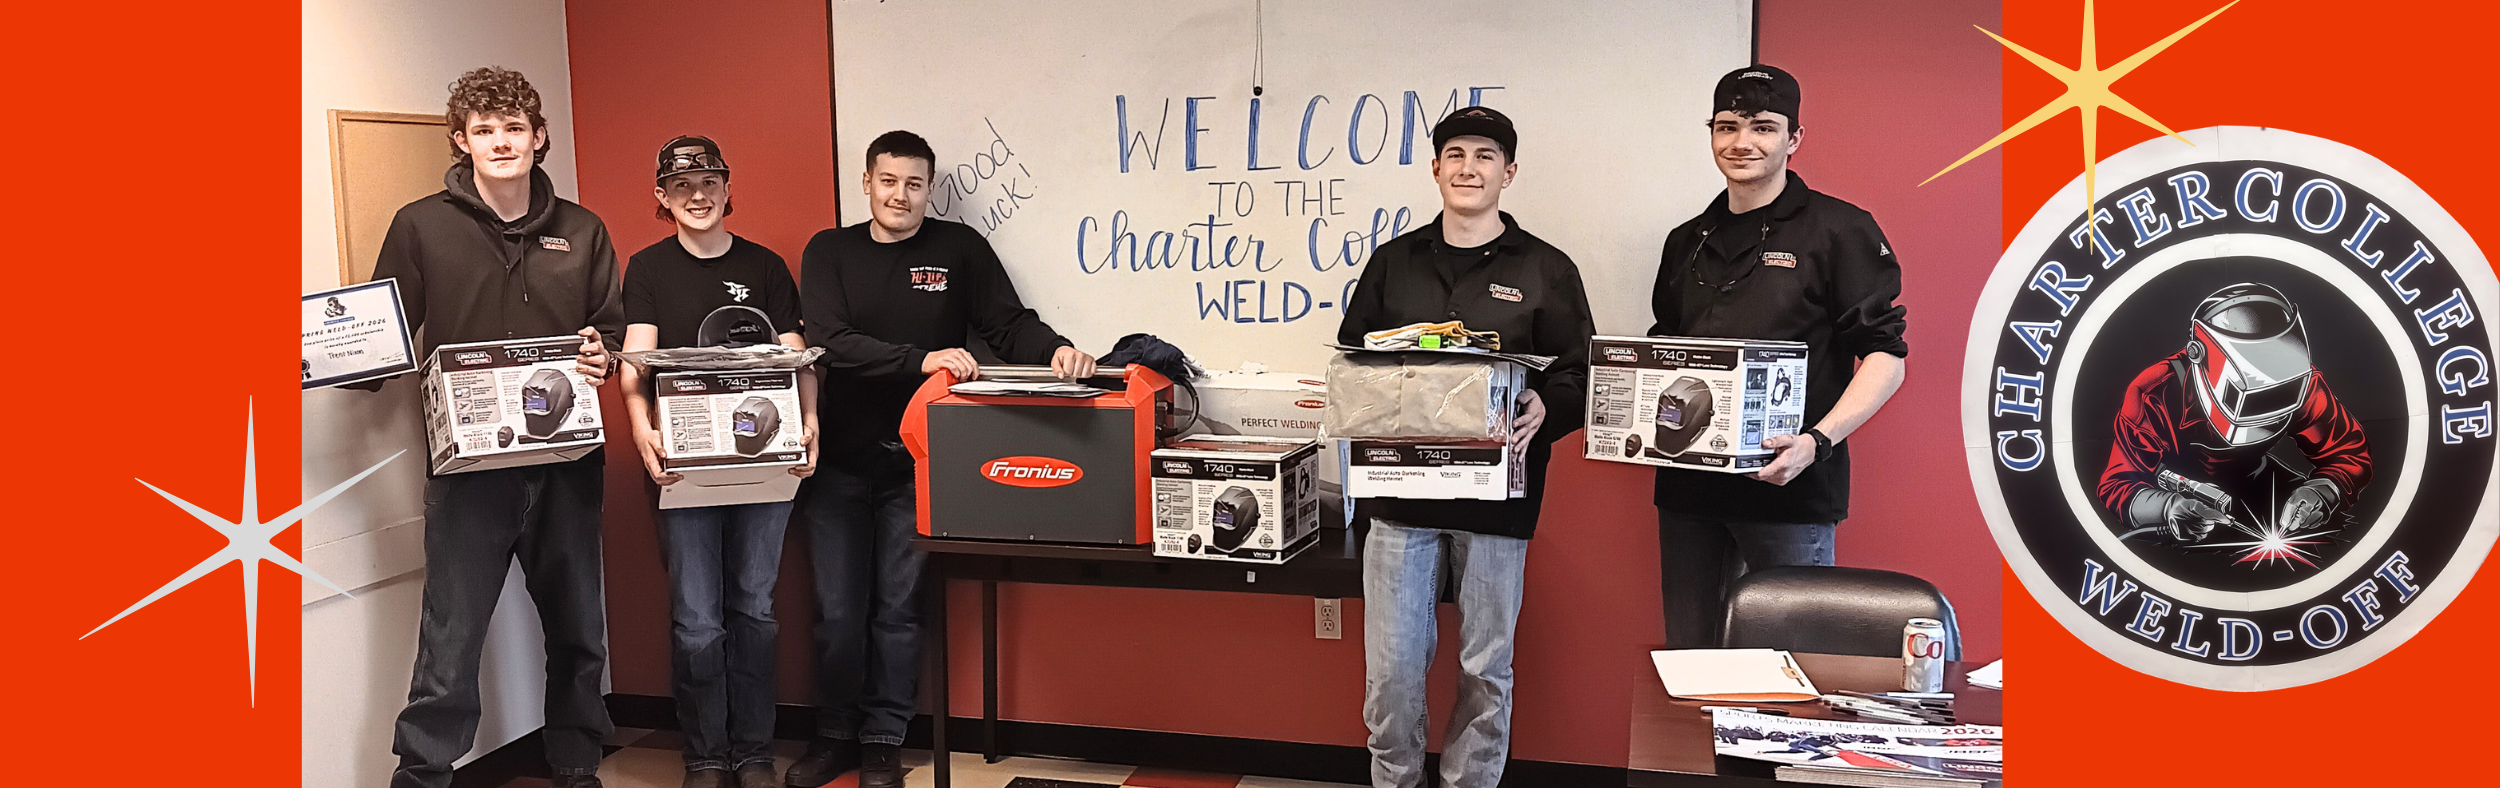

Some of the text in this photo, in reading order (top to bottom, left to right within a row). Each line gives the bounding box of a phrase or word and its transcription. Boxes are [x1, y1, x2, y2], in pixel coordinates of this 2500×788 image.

[1115, 87, 1506, 172] WELCOM
[1208, 179, 1346, 217] TO THE
[1077, 209, 1283, 275] Charter
[367, 318, 386, 326] 2026
[504, 348, 539, 358] 1740
[1651, 350, 1687, 361] 1740
[718, 378, 750, 387] 1740
[1241, 418, 1278, 428] PERFECT
[1417, 450, 1451, 460] 1740
[1164, 461, 1188, 469] LINCOLN
[1701, 456, 1723, 466] VIKING
[989, 461, 1076, 480] Fronius
[1204, 464, 1234, 473] 1740
[1862, 724, 1938, 734] CALENDAR
[1940, 727, 1995, 735] 2026
